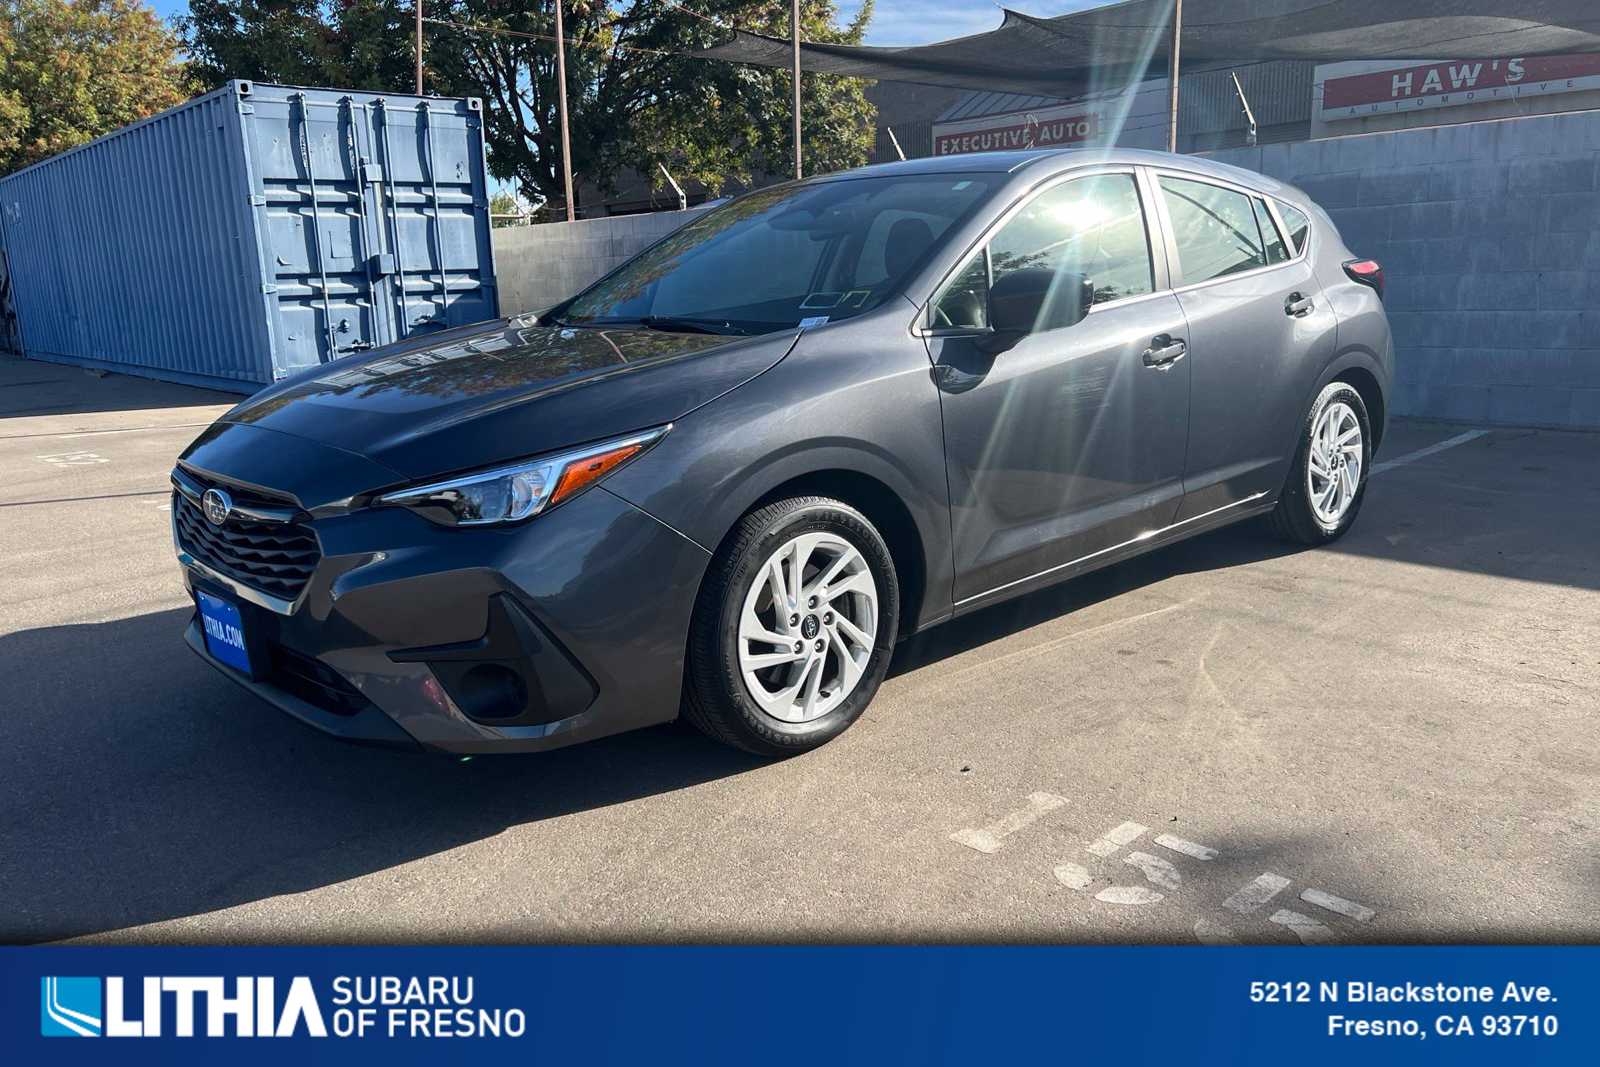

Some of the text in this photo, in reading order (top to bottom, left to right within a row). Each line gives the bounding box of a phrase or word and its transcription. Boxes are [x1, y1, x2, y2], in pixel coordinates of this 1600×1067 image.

[1391, 58, 1526, 97] HAW'S
[1350, 80, 1574, 115] AUTOMOTIVE
[941, 121, 1091, 154] EXECUTIVE AUTO
[202, 612, 245, 651] LITHIA.COM
